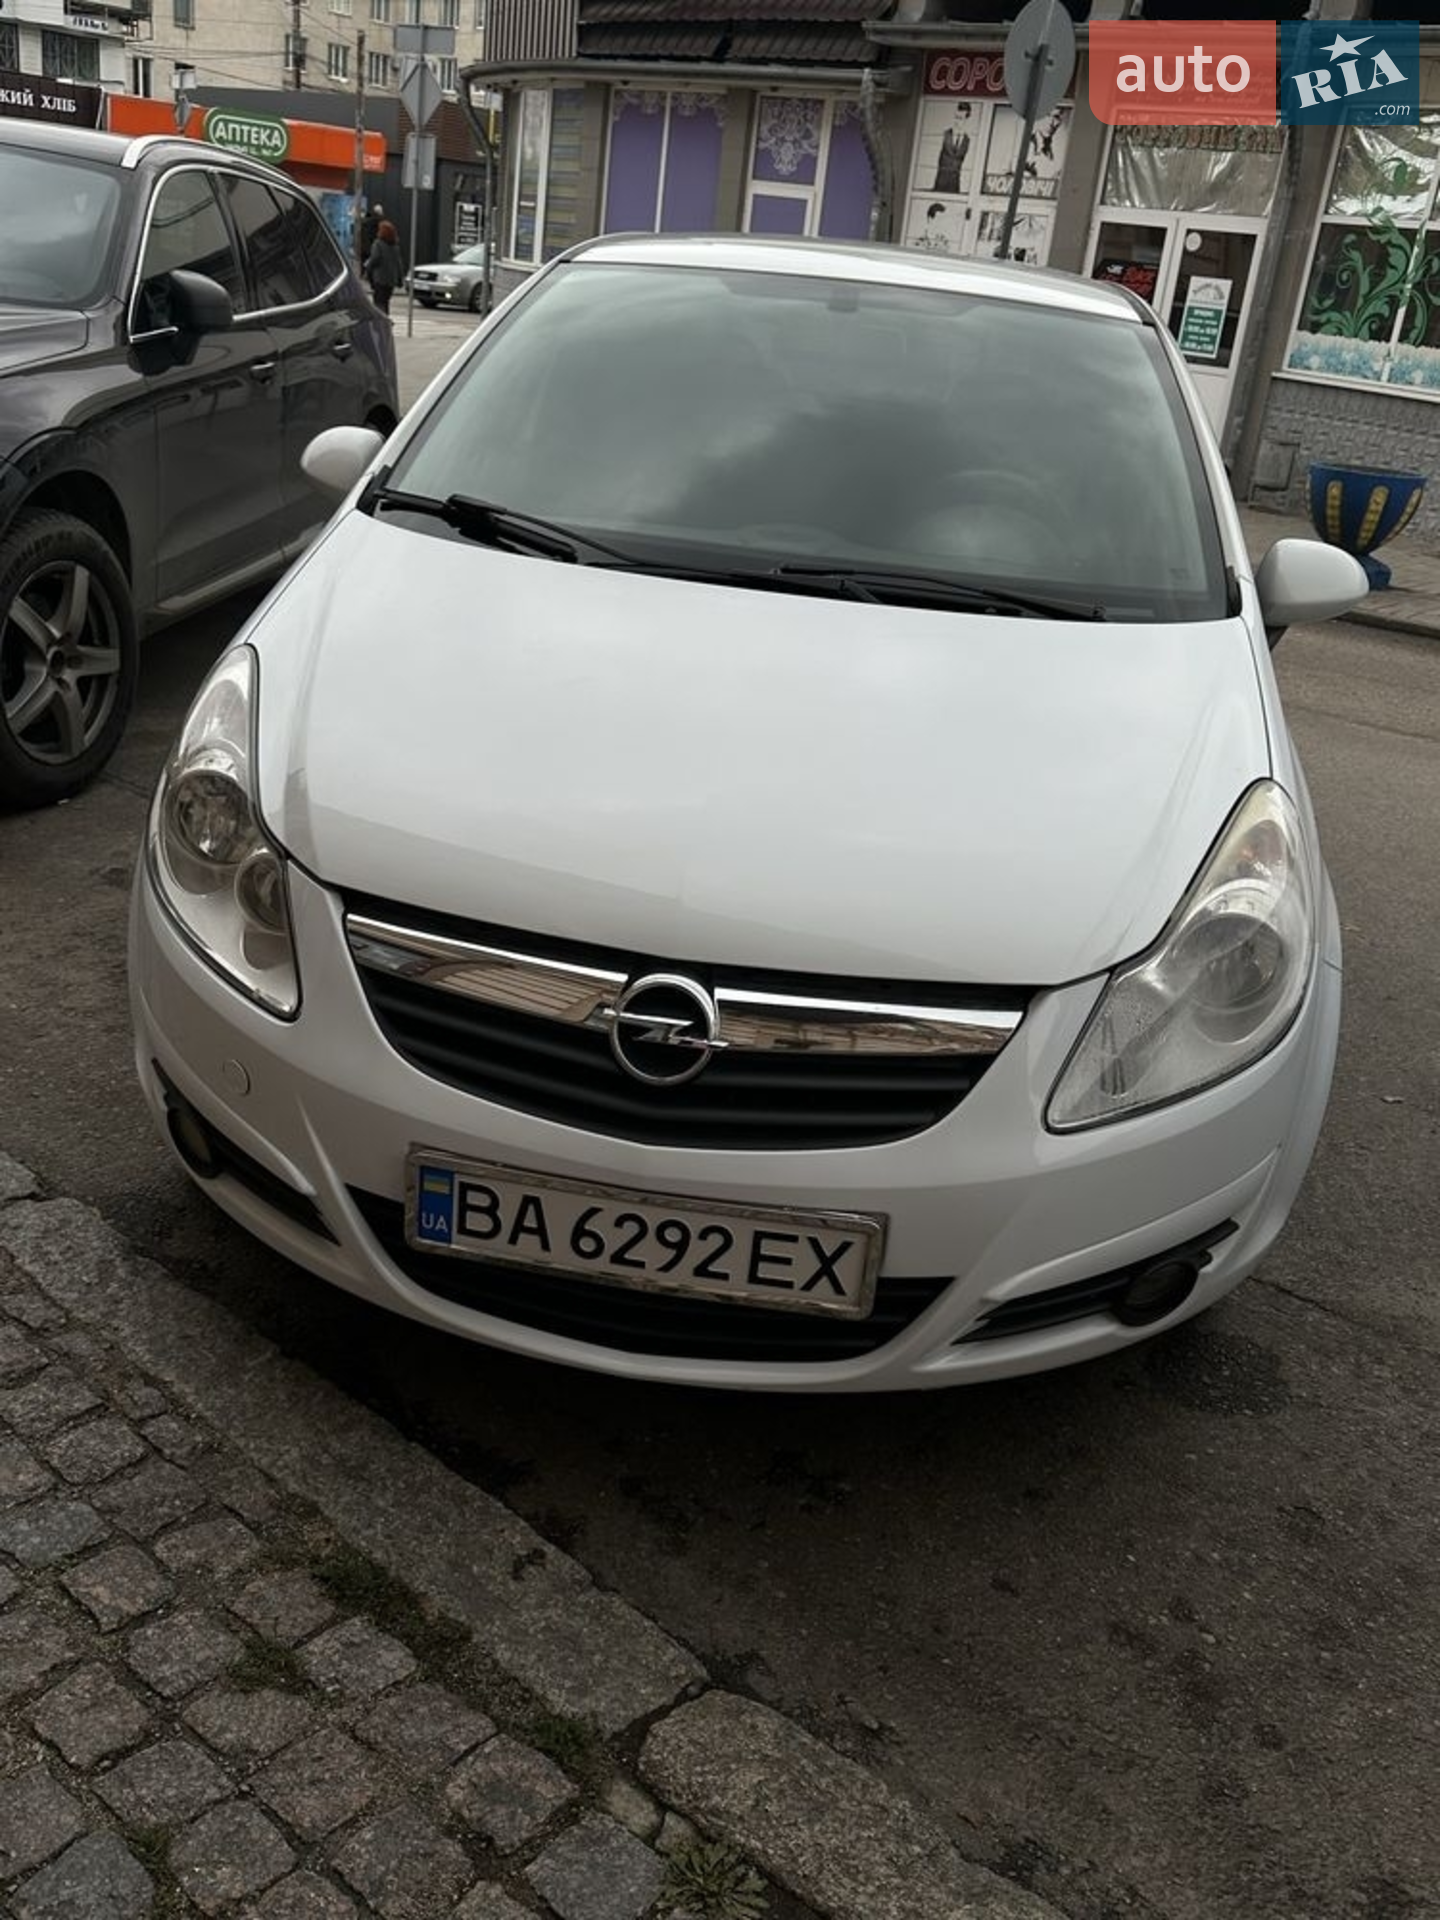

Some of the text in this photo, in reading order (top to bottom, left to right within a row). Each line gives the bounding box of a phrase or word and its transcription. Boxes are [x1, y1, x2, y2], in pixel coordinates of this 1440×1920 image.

[929, 57, 1005, 91] СОРО
[41, 94, 76, 112] ХЛІБ
[215, 121, 281, 148] АПТЕКА
[987, 176, 1054, 197] ЧОЛВІЧІ
[422, 1212, 448, 1232] UA
[457, 1181, 854, 1295] BA 6292 EX
